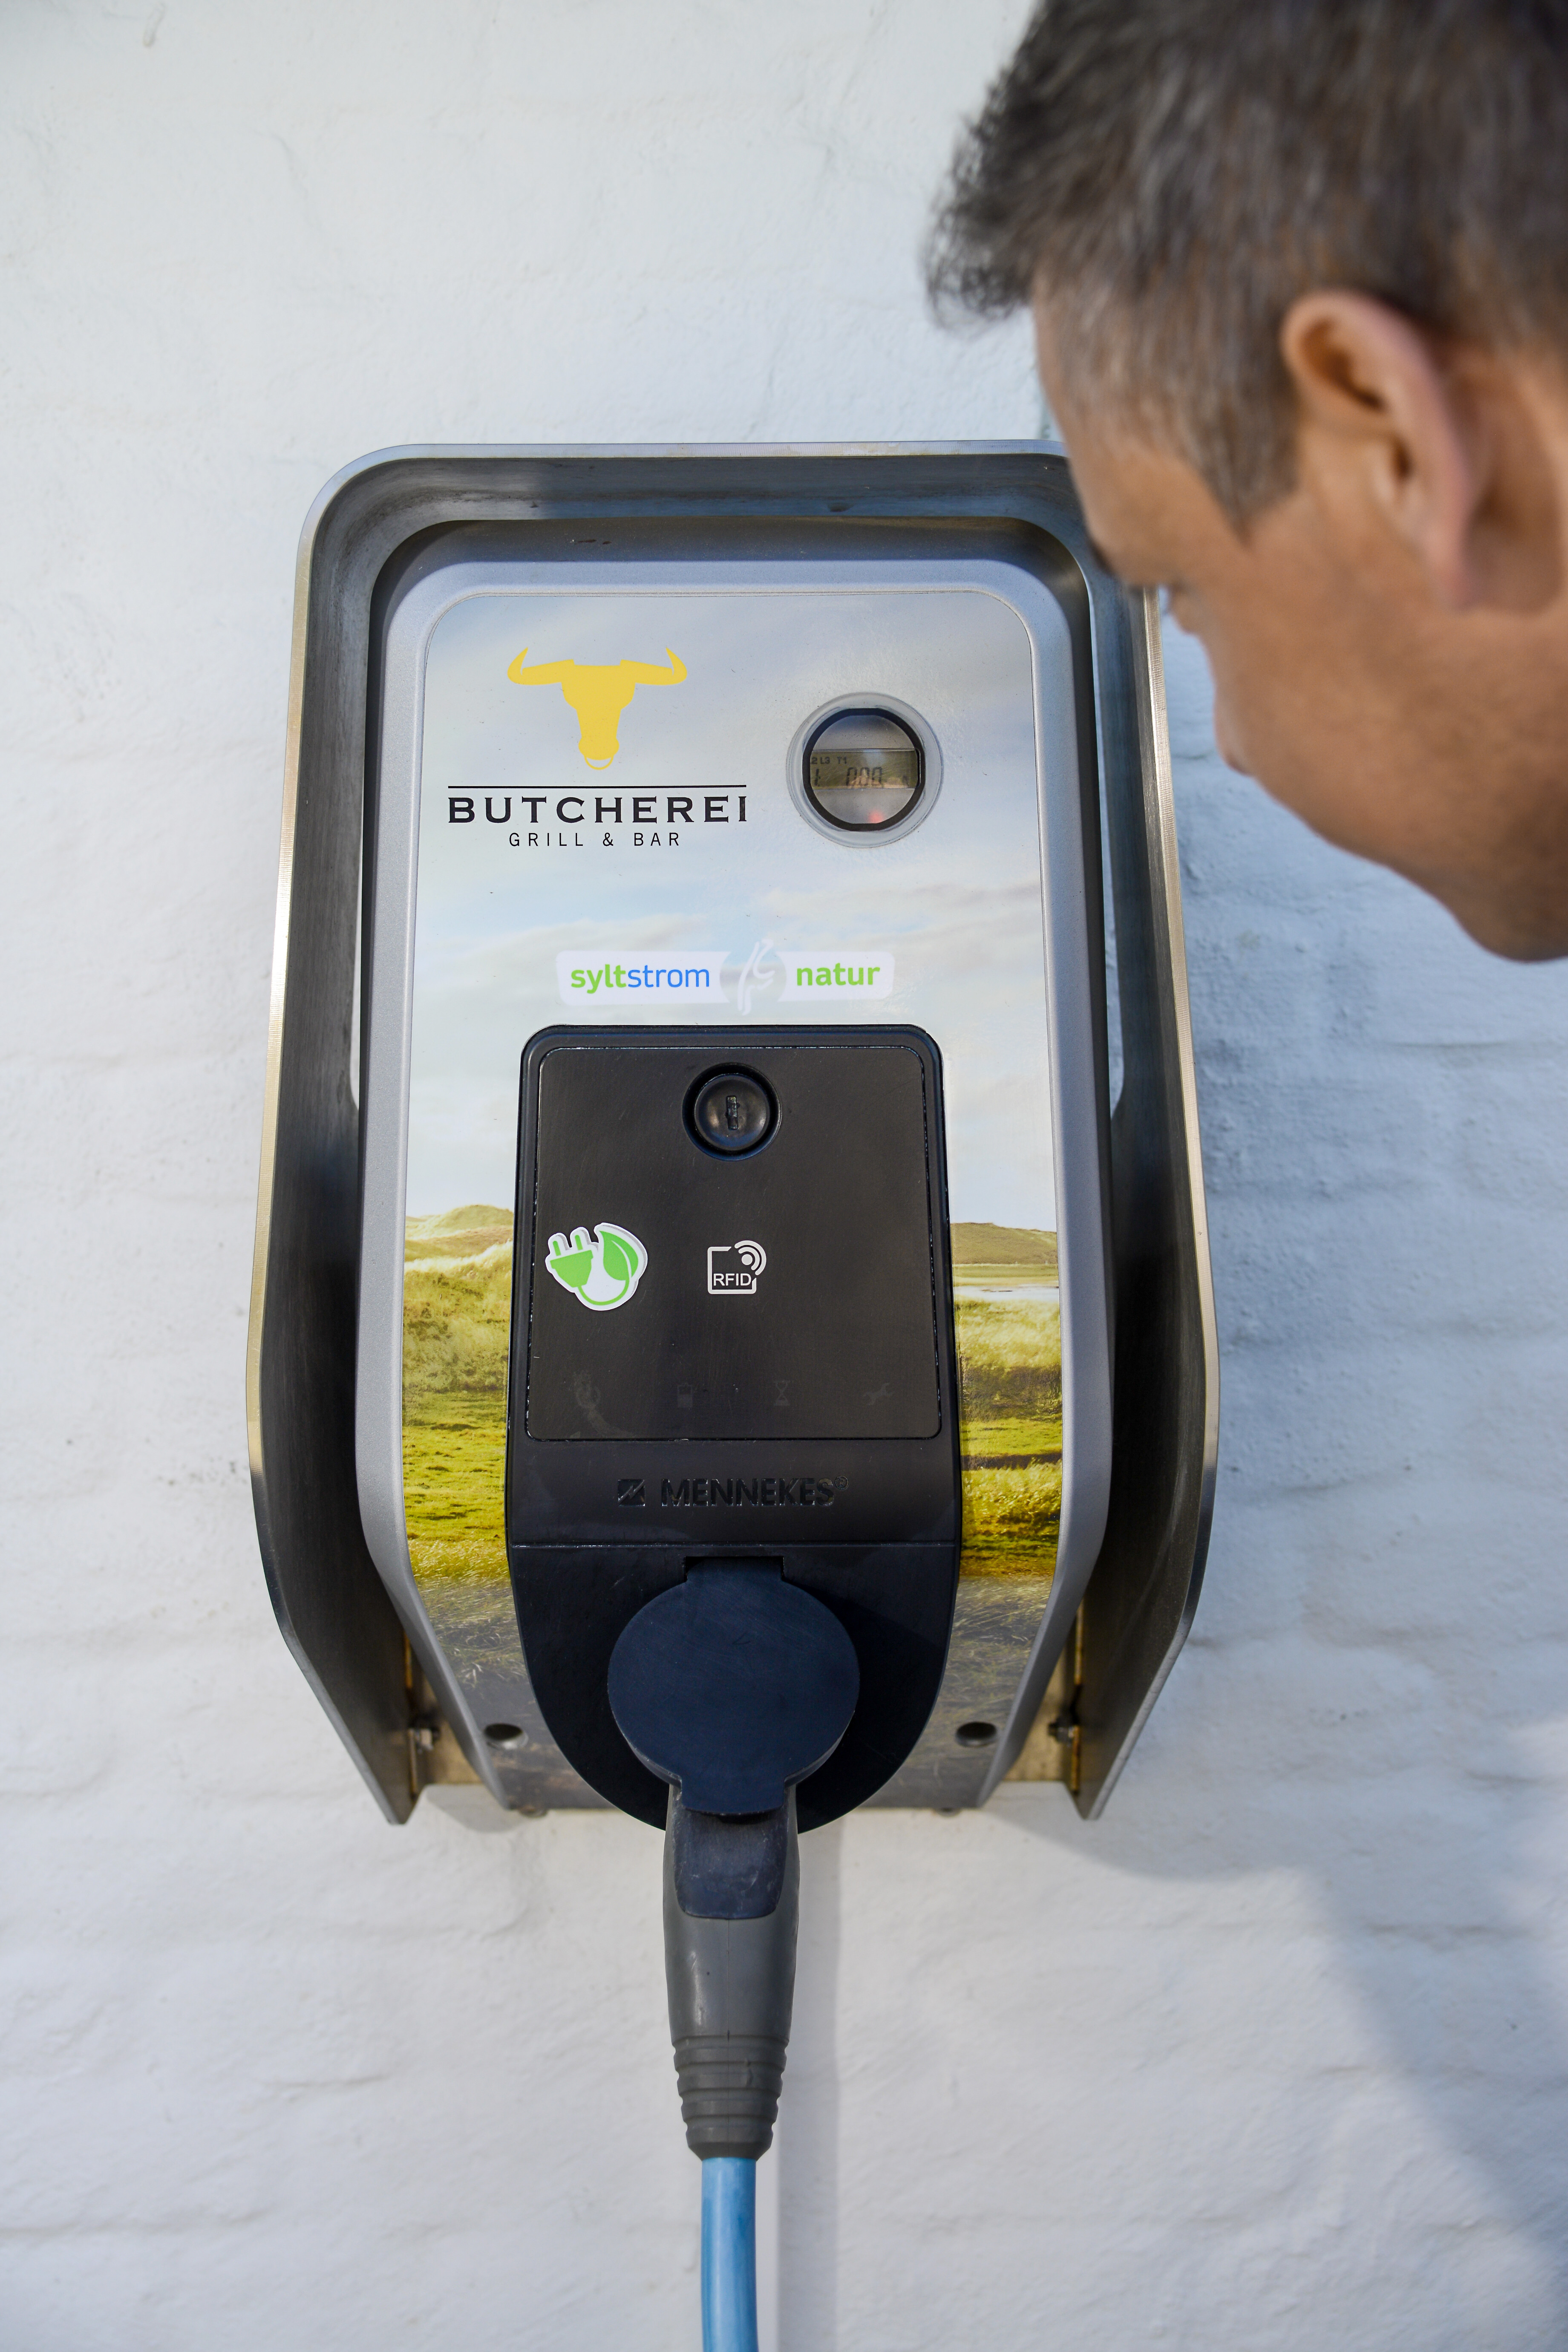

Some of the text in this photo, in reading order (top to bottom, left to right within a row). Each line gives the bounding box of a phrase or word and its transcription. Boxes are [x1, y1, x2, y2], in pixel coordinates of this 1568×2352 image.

[837, 756, 847, 764] T1
[448, 795, 747, 824] BUTCHEREI
[509, 832, 679, 847] GRILL & BAR
[571, 963, 881, 994] syltstrom natur
[713, 1273, 752, 1286] RFID
